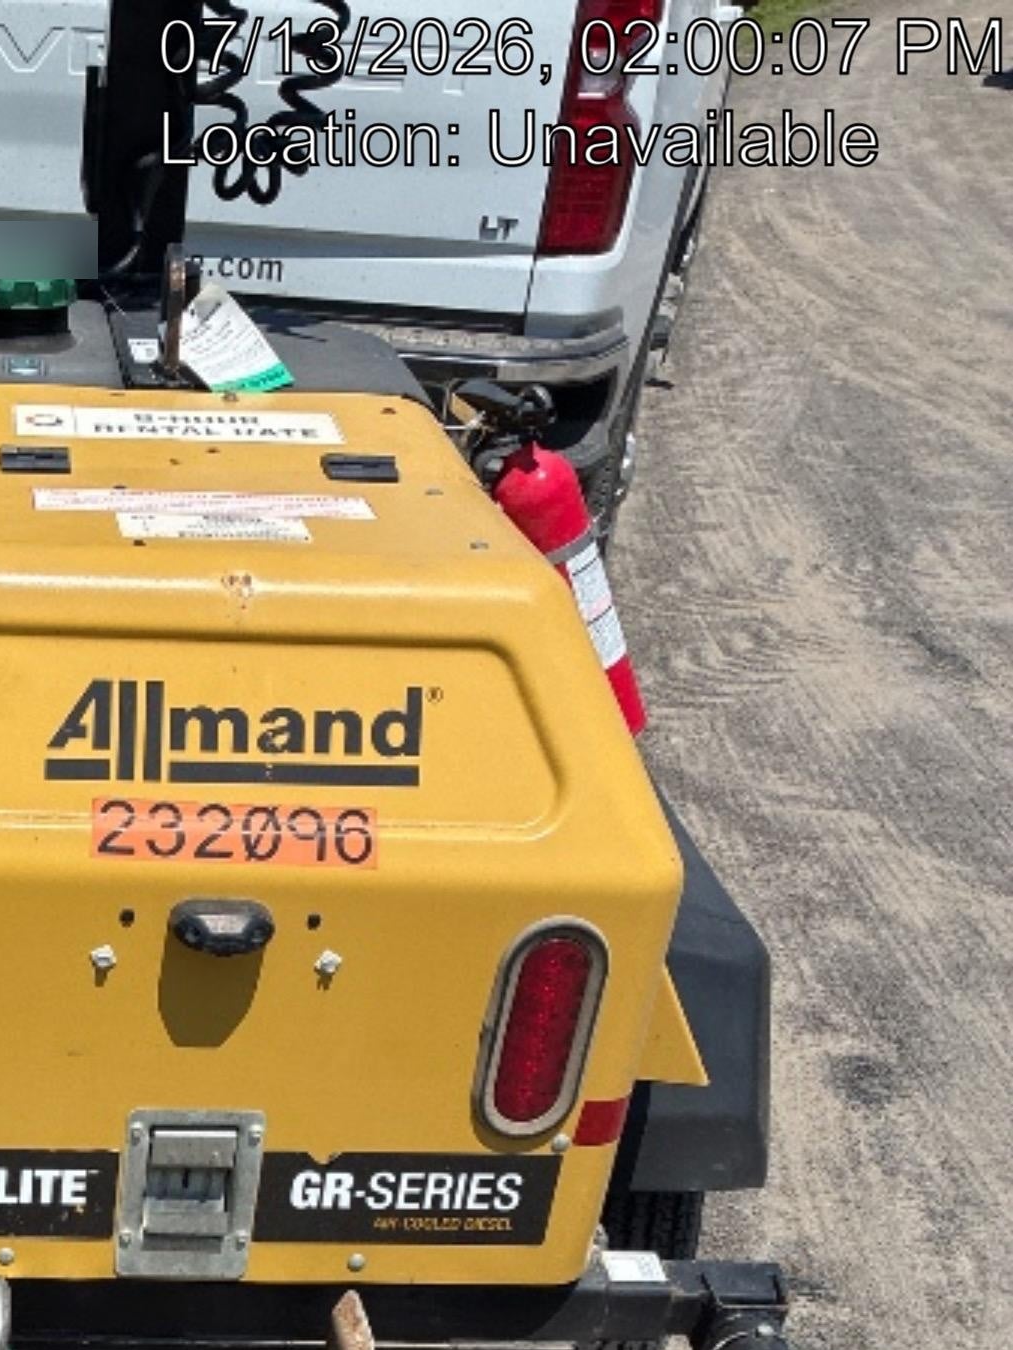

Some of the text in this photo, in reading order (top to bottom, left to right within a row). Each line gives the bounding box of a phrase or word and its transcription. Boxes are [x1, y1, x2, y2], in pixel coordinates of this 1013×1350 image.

[479, 215, 519, 240] LT
[45, 679, 423, 787] Allmand
[289, 1170, 524, 1211] GR-SERIES
